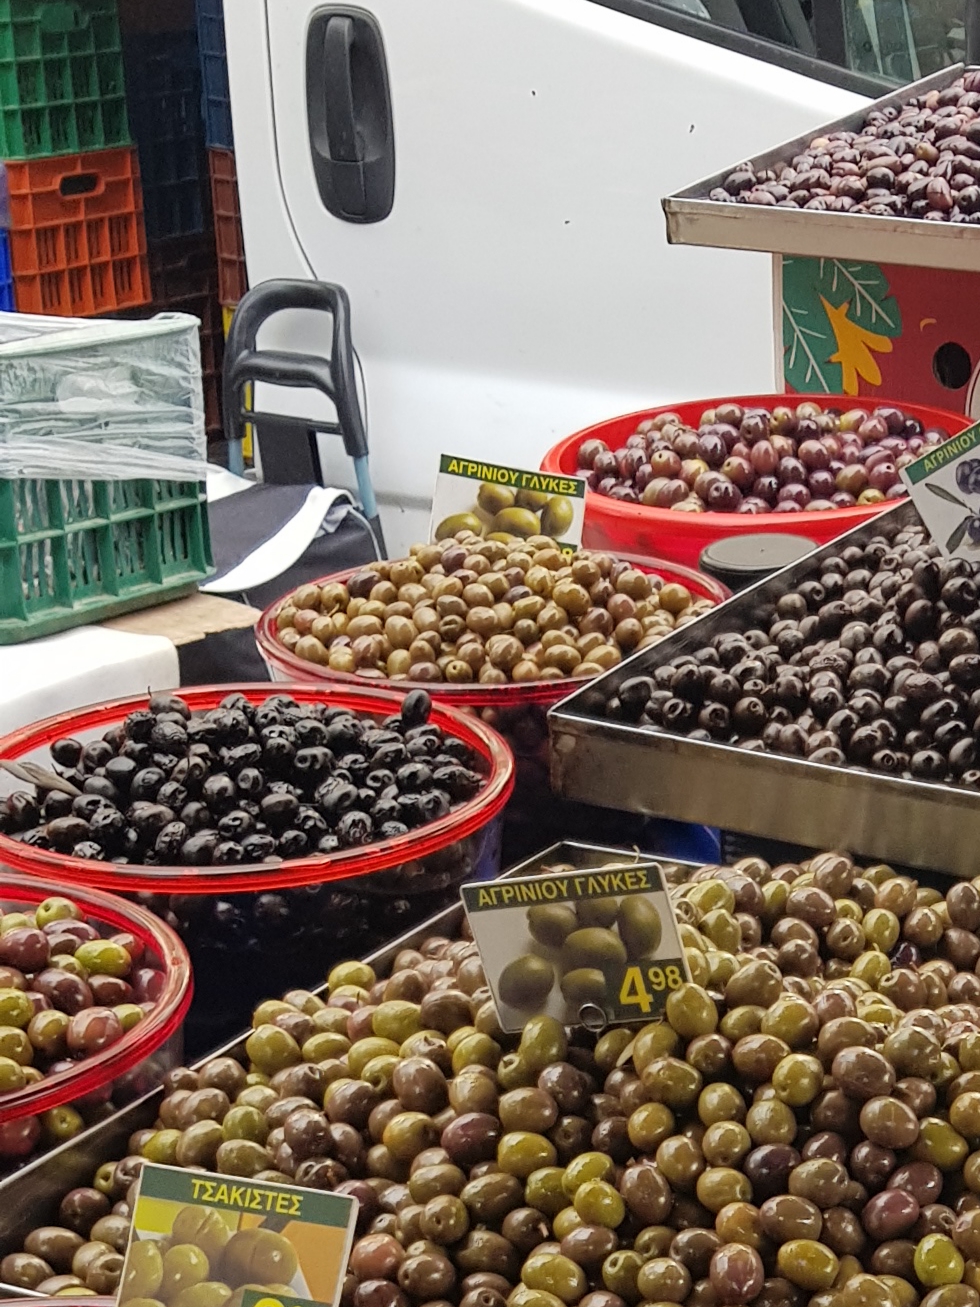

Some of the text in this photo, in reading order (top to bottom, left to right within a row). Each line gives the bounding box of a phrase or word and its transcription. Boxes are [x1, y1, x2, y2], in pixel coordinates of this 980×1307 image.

[923, 431, 976, 473] ΑΓΡΙΝΙΟΥ
[448, 459, 577, 494] ΑΓΡΙΝΙΟΥ ΓΛΥΚΕΣ
[478, 870, 651, 907] ΑΓΡΙΝΙΟΥ ΓΛΥΚΕΣ
[191, 1178, 303, 1215] ΤΣΑΚΙΣΤΕΣ
